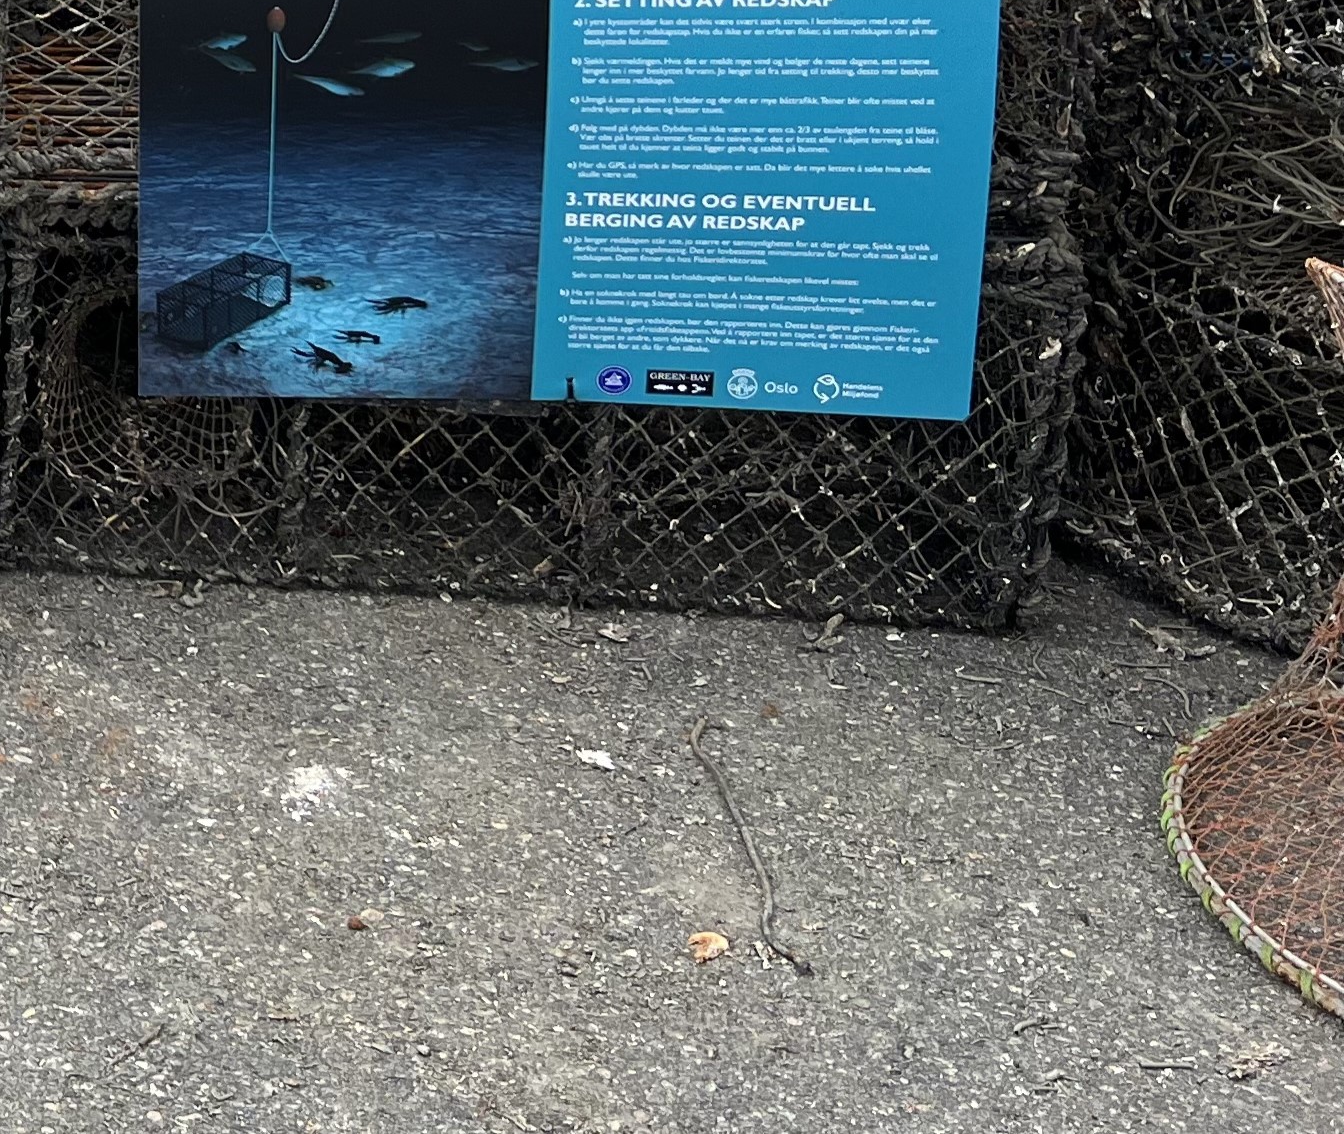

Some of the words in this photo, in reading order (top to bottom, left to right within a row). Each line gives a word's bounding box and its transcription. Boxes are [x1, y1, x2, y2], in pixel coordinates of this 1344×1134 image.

[583, 192, 696, 208] TREKKING
[701, 194, 737, 209] OG
[743, 194, 876, 212] EVENTUELL
[564, 213, 662, 228] BERGING
[666, 215, 697, 229] AV
[702, 215, 805, 231] REDSKAP
[649, 371, 711, 383] GREEN-BAY
[764, 381, 799, 395] Oslo
